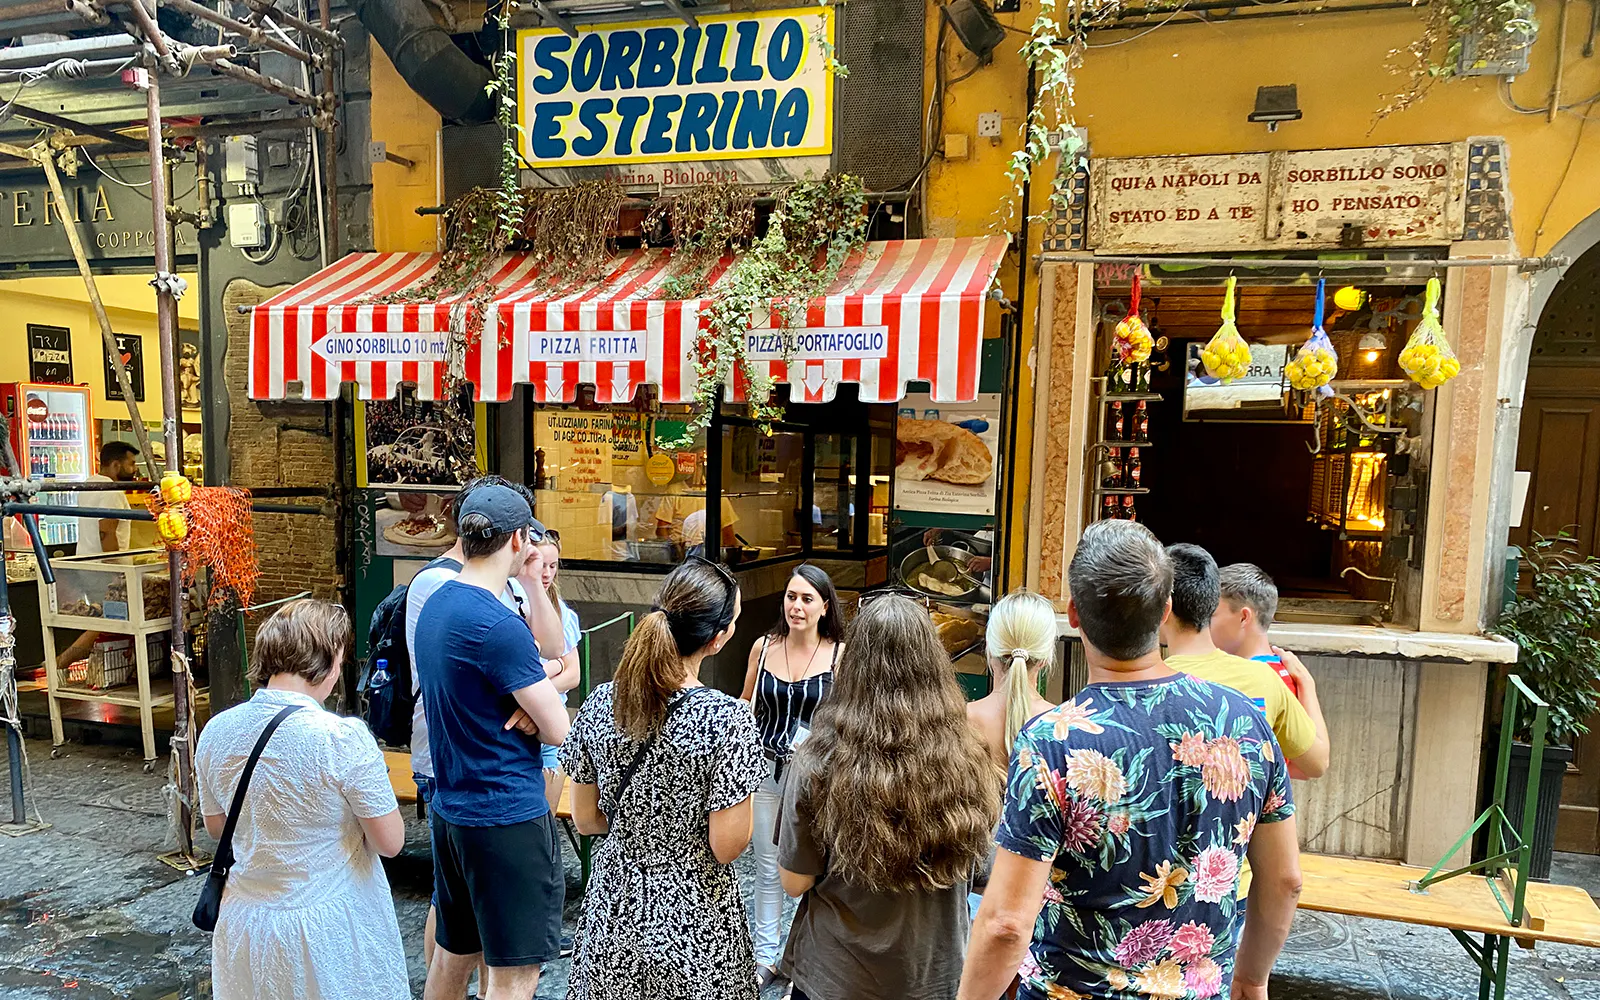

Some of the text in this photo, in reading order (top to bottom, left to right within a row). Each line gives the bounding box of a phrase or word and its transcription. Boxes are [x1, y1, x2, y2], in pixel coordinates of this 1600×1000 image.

[532, 18, 804, 95] SORBILLO
[531, 87, 810, 159] ESTERINA
[663, 167, 739, 185] Biologica
[1111, 164, 1447, 192] QUI A NAPOLI DA SORBILLO SONO
[1109, 209, 1166, 224] STATO
[1175, 209, 1200, 221] ED
[1207, 208, 1219, 220] A
[1229, 206, 1254, 219] TE
[1292, 199, 1320, 213] HO
[96, 229, 186, 249] COPPOA
[326, 338, 353, 354] GINO
[356, 338, 411, 354] SORBILLO
[414, 339, 427, 354] 10
[541, 337, 638, 354] PIZZA FRITTA
[748, 335, 782, 353] PIZZA
[797, 332, 884, 352] PORTAFOGLIO
